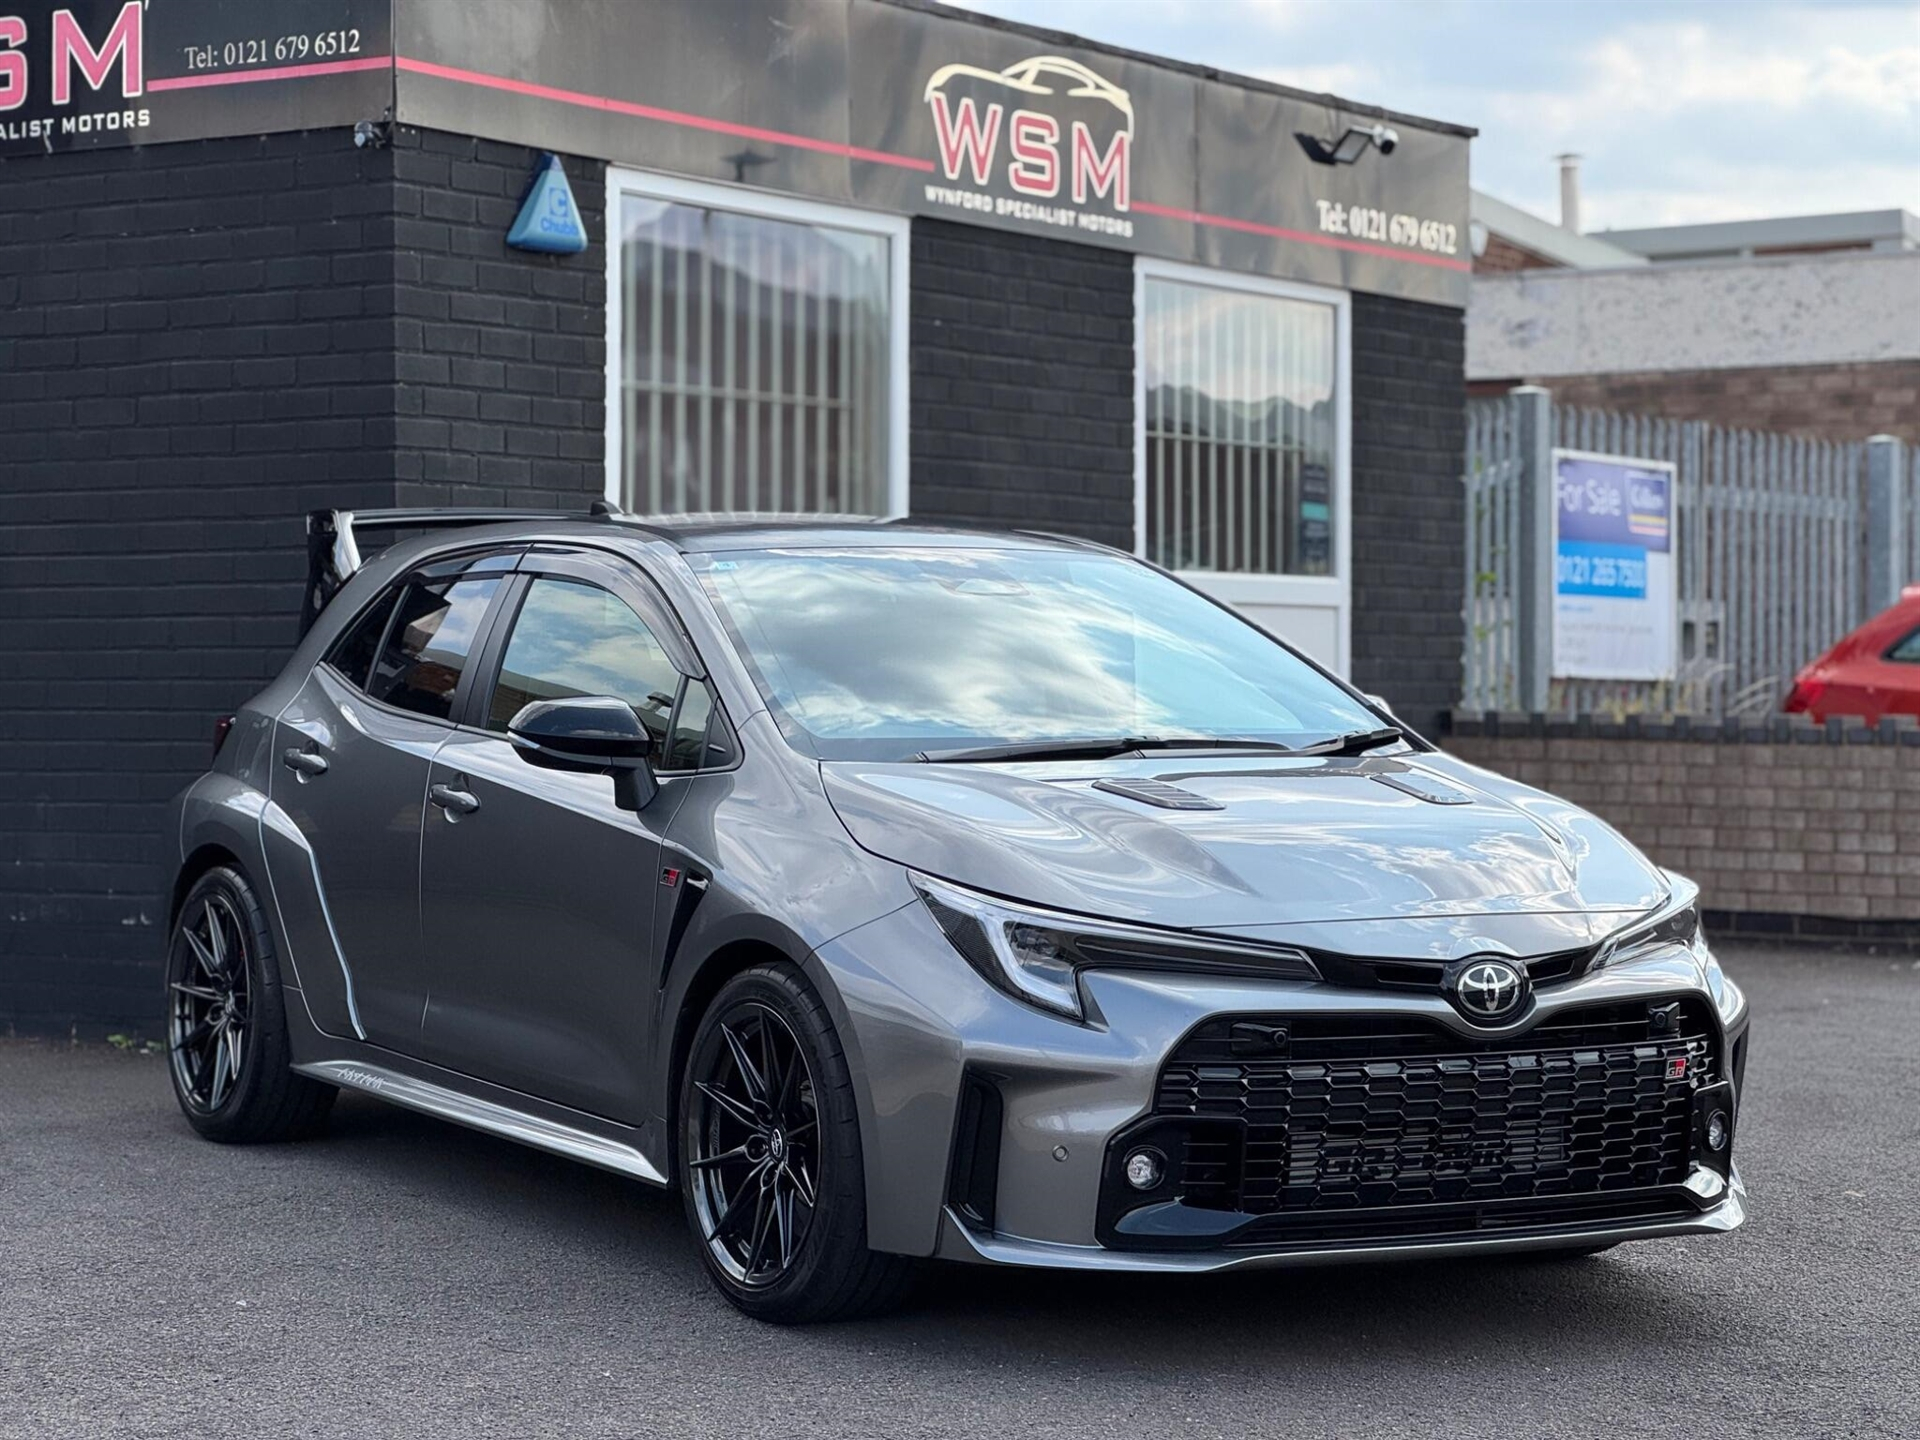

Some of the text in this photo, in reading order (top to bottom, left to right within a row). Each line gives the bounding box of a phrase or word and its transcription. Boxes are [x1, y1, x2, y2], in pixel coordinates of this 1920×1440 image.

[184, 29, 360, 69] Tel: 0121 679 6512
[62, 109, 150, 134] MOTORS
[930, 90, 1132, 212] WSM
[925, 185, 1133, 238] WYNFORD SPECIALIST MOTORS
[1349, 206, 1387, 241] 0121
[1390, 213, 1419, 247] 679
[1420, 219, 1457, 255] 6512
[1586, 478, 1621, 517] Sale
[1667, 1067, 1684, 1077] GR
